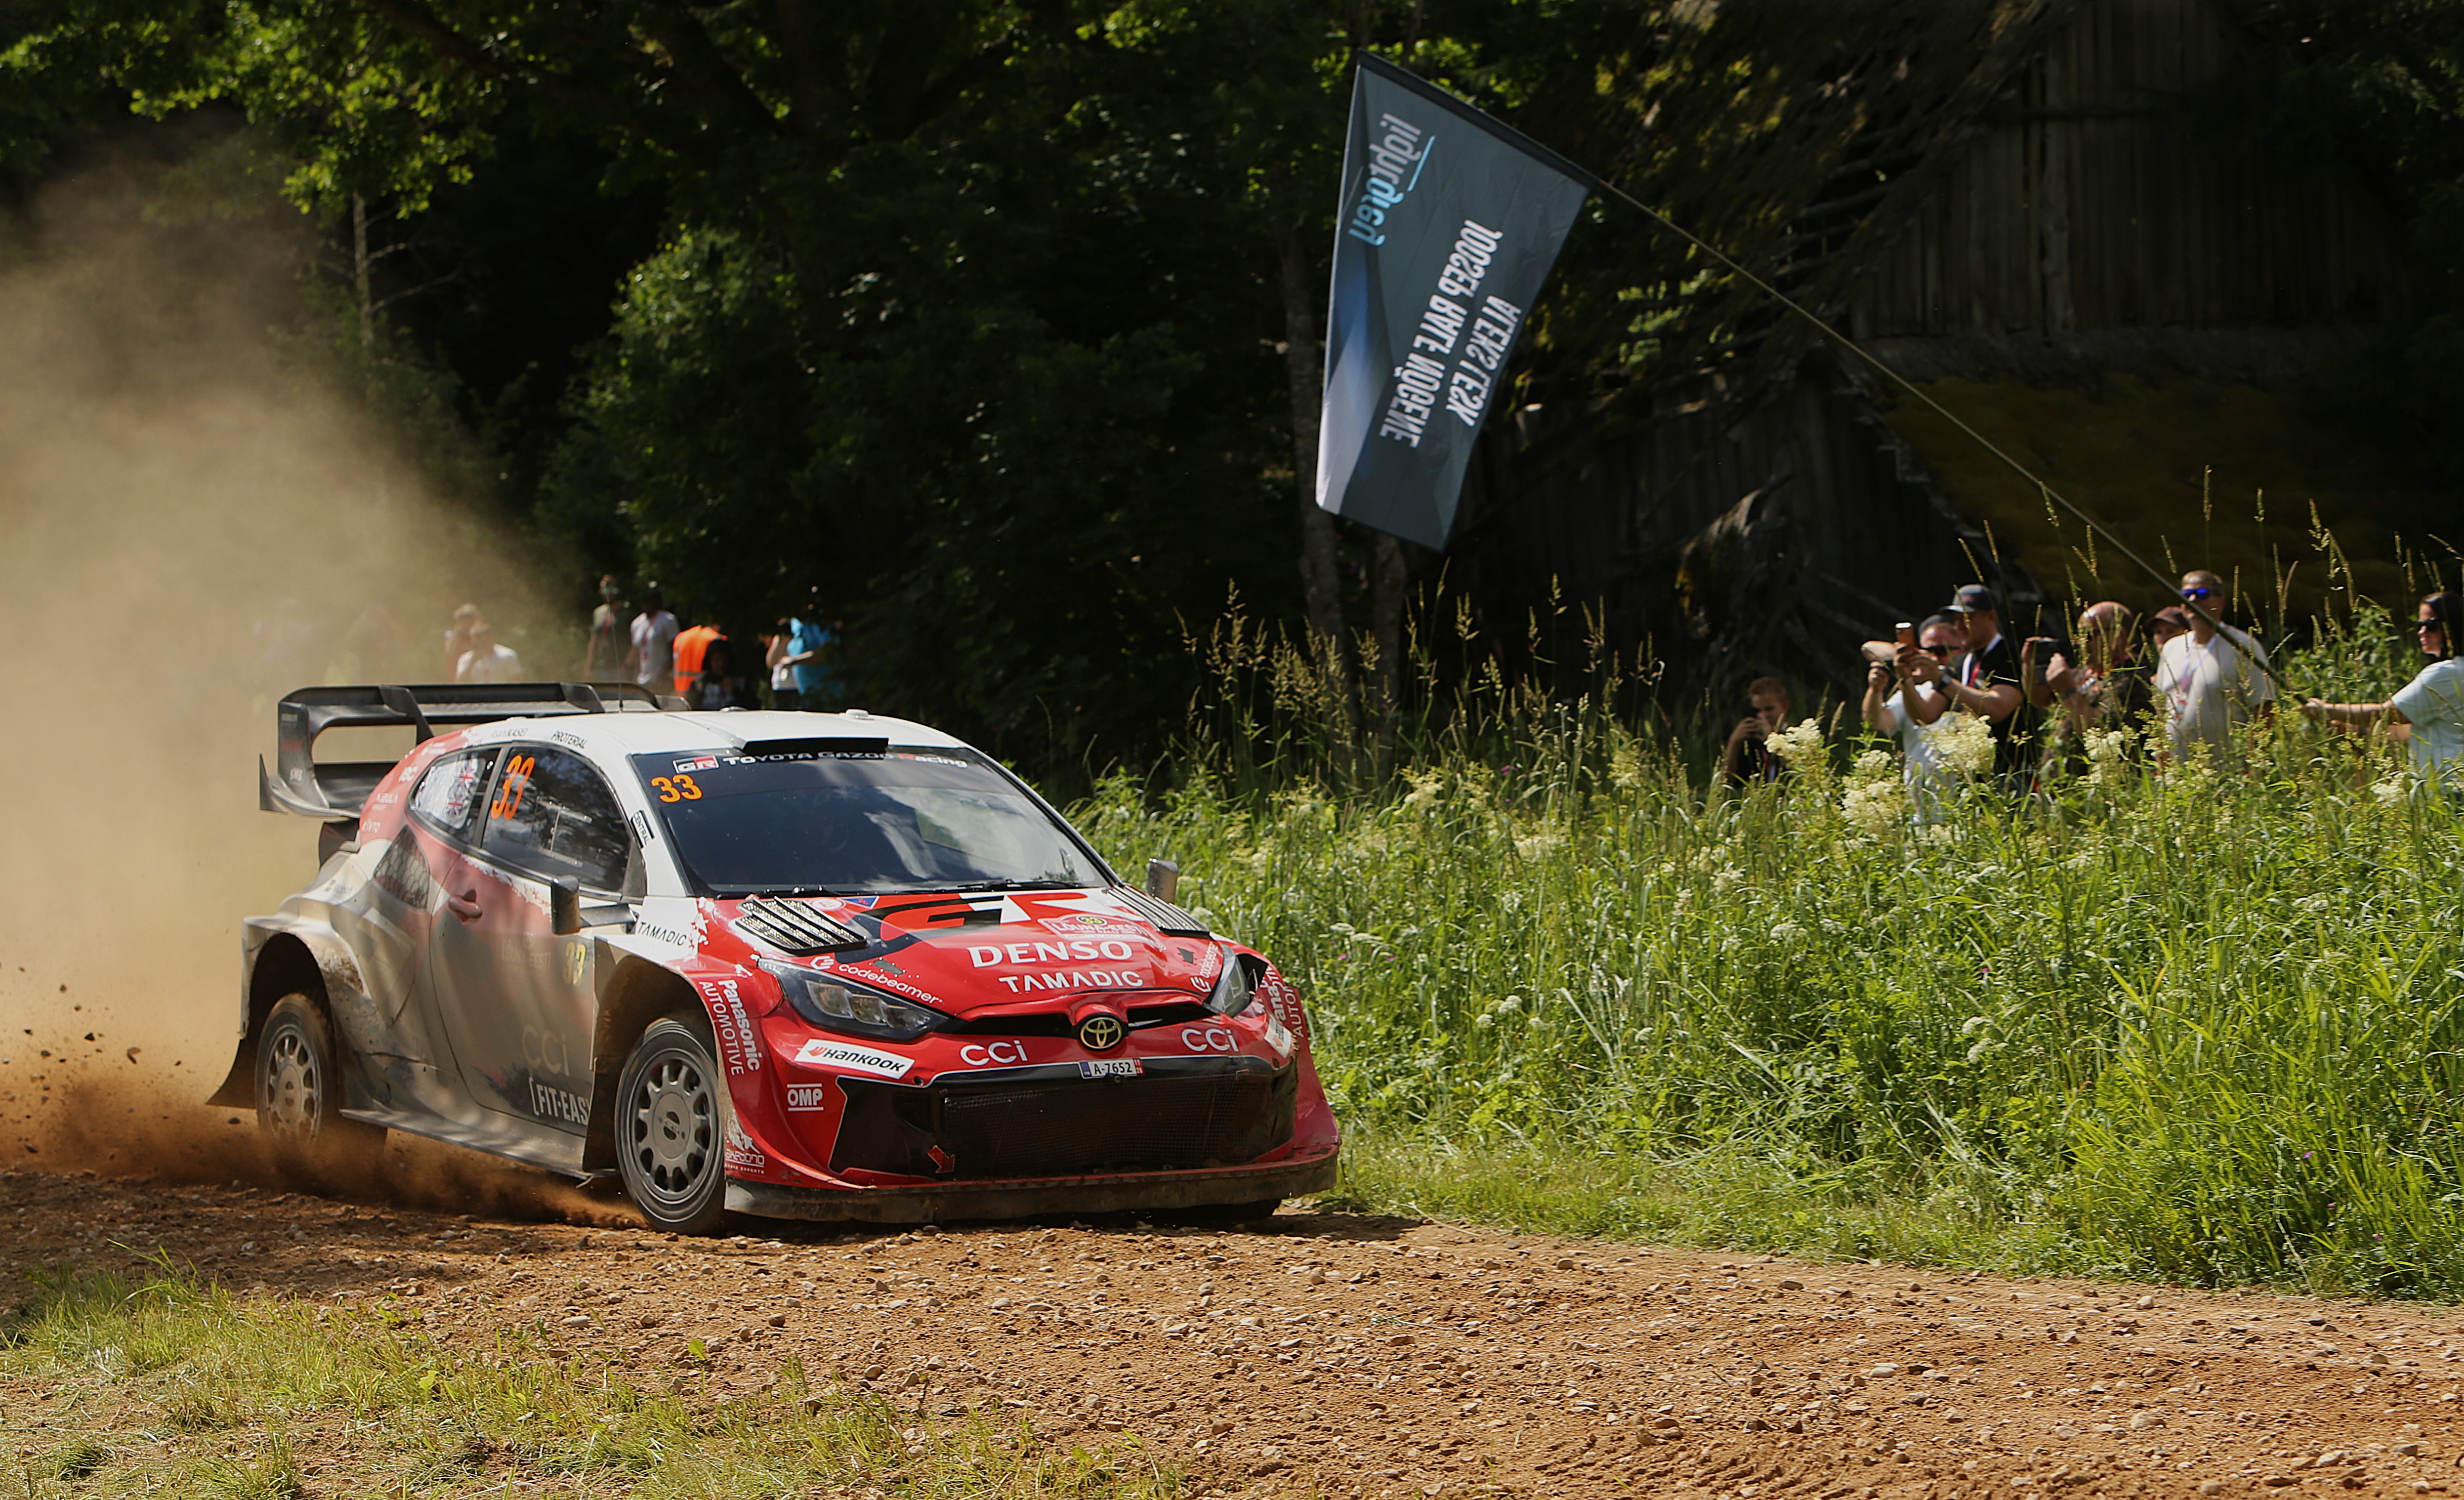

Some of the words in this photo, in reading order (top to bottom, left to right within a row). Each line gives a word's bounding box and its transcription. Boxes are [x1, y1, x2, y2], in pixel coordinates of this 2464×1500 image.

[550, 730, 587, 749] PROTERIAL
[677, 759, 717, 772] GR
[723, 752, 813, 766] TOYOTA
[817, 751, 894, 760] GAZOO
[491, 755, 535, 820] 33
[651, 774, 703, 803] 33
[633, 810, 650, 846] CENTRAL
[637, 921, 687, 946] TAMADIC
[966, 940, 1132, 969] DENSO
[839, 963, 941, 1004] codebeamer
[998, 969, 1143, 994] TAMADIC
[699, 981, 745, 1076] AUTOMOTIVE
[718, 979, 760, 1071] Panasonic
[1094, 1062, 1132, 1074] A-7652
[787, 1089, 824, 1107] OMP
